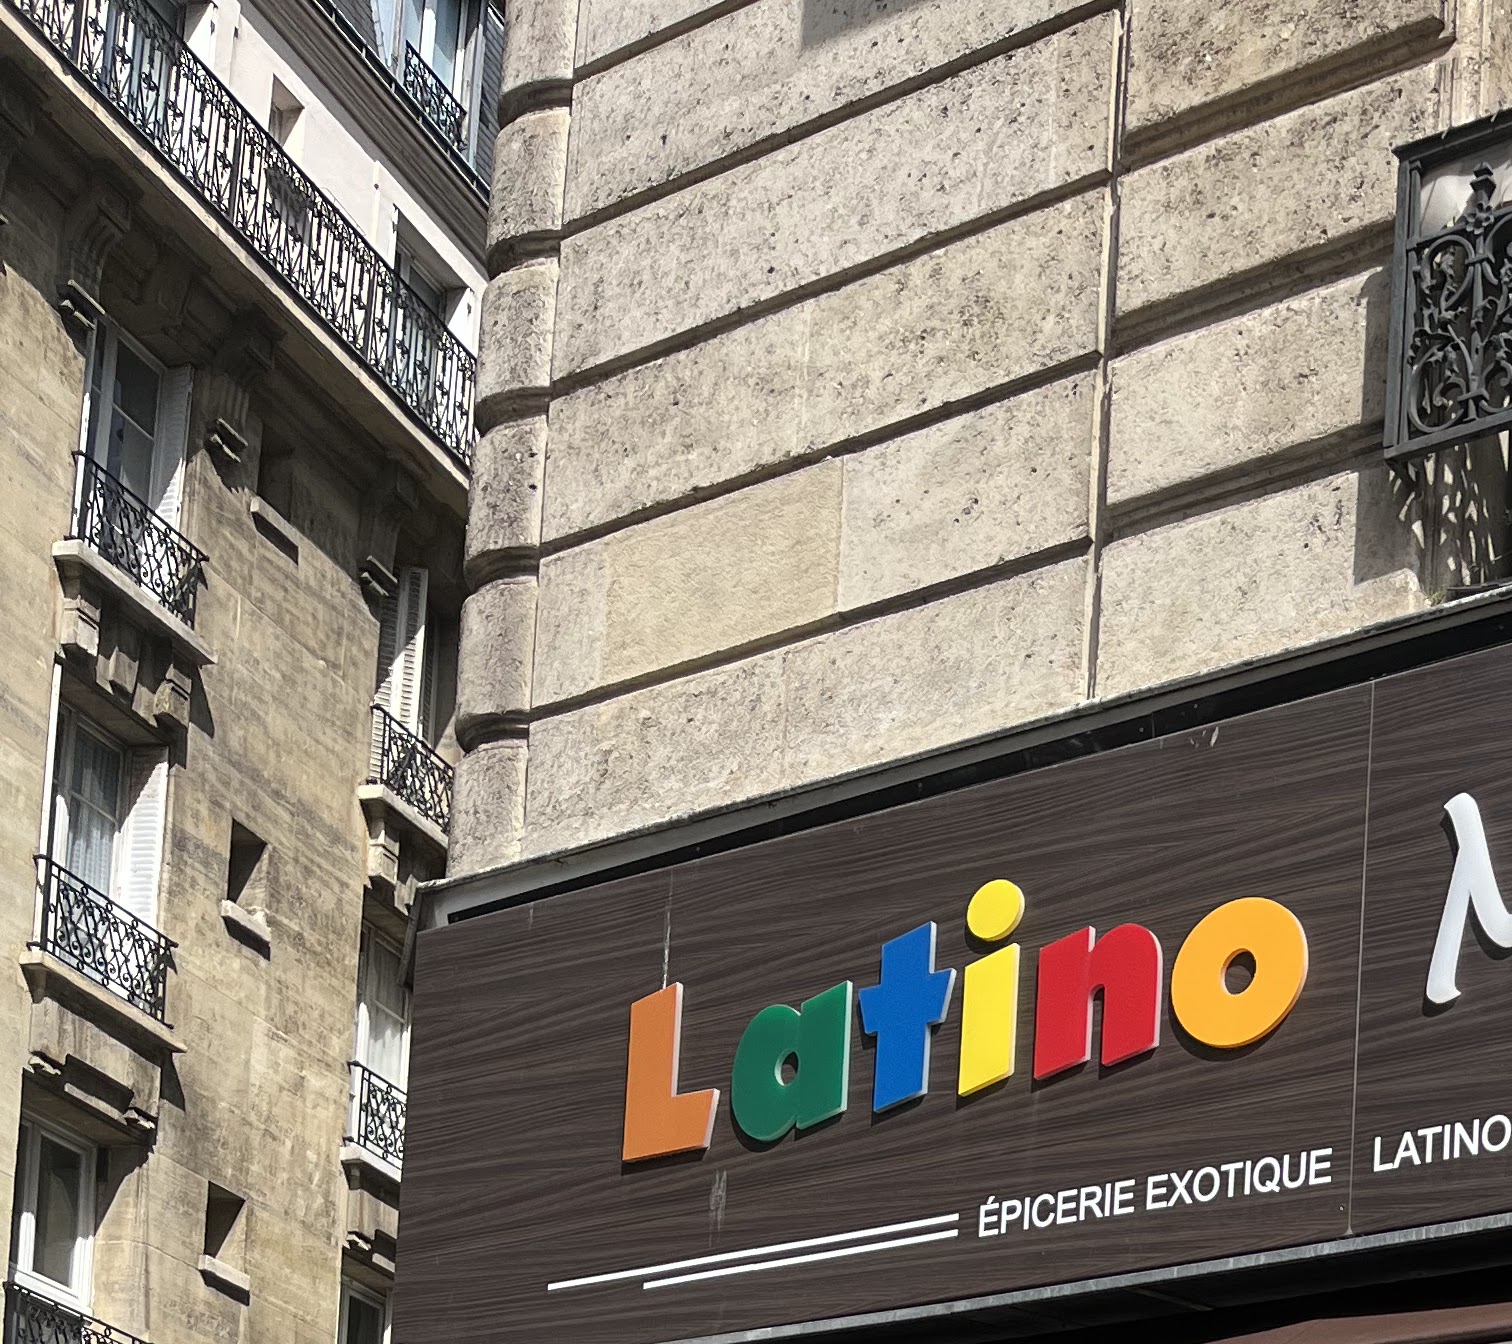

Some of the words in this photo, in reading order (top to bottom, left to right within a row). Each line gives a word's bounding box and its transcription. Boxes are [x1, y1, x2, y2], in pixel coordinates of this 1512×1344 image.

[622, 879, 1309, 1162] Latino
[977, 1178, 1135, 1238] ÉPICERIE
[1145, 1147, 1333, 1212] EXOTIQUE
